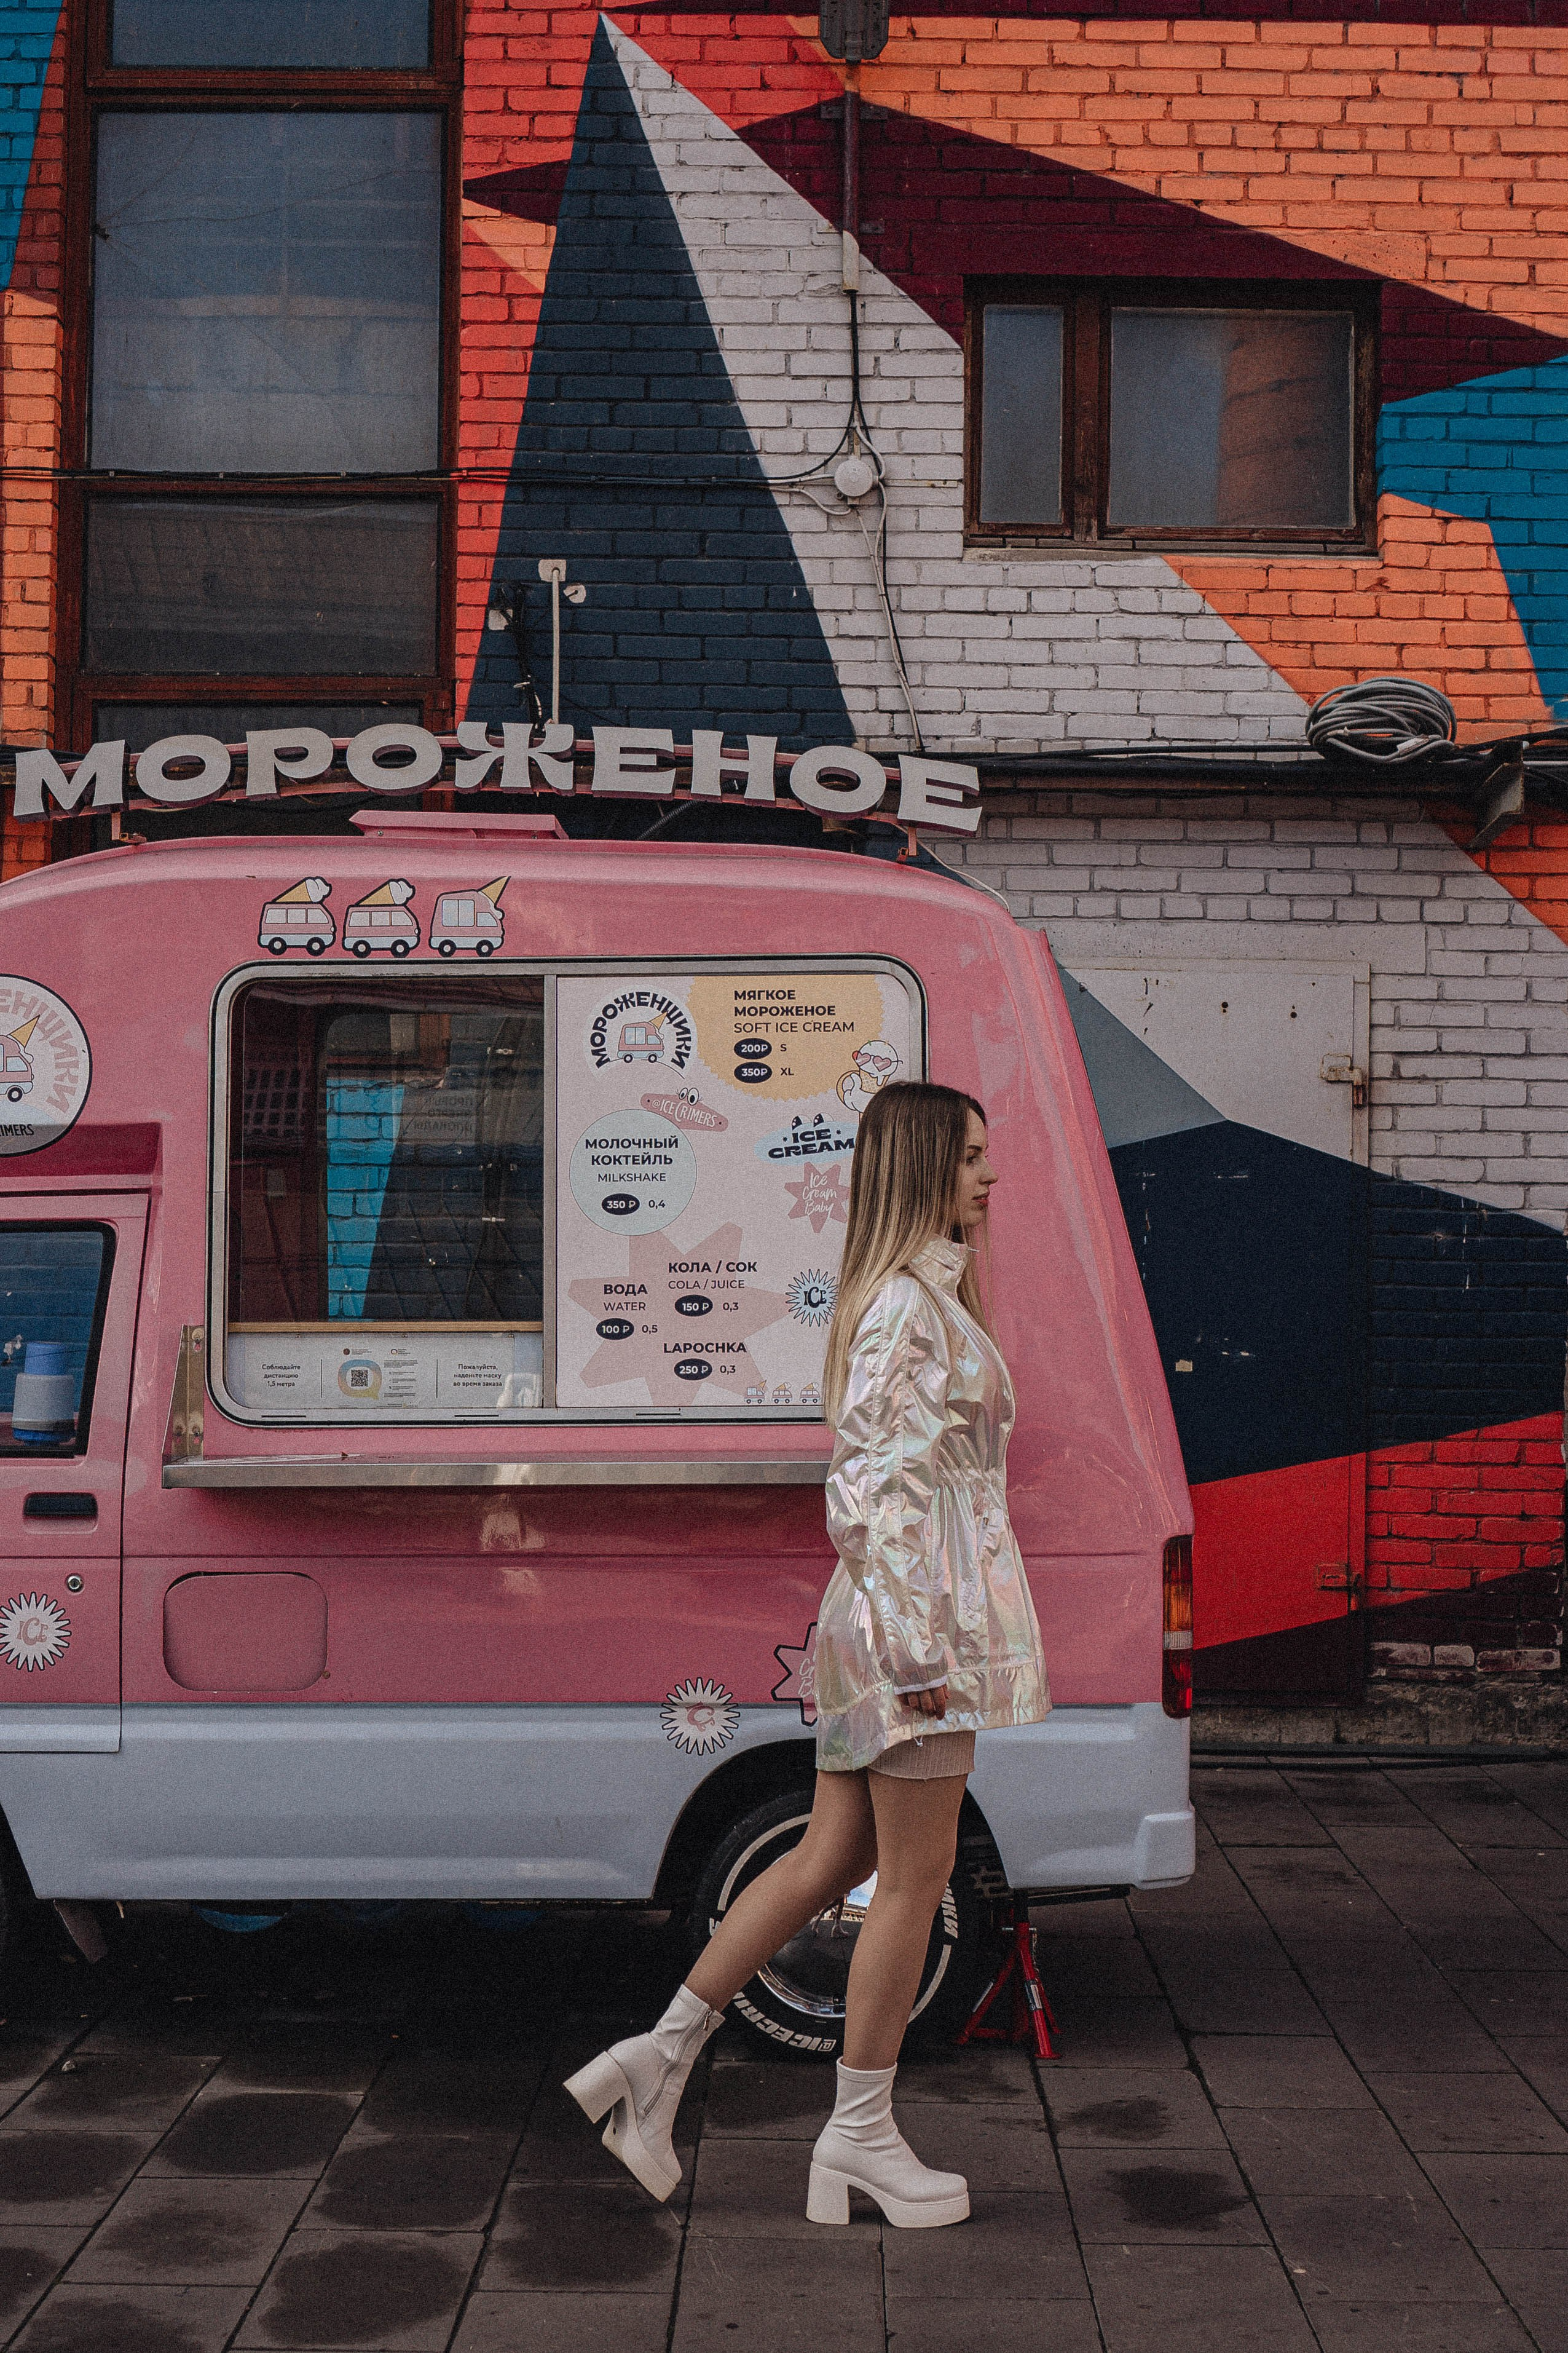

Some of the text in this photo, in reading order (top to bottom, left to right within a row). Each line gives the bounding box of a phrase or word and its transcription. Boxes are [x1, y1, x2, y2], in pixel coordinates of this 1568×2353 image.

[12, 721, 983, 833] МОРОЖЕНОЕ
[734, 989, 796, 1000] МЯГКОЕ
[734, 1005, 836, 1017] МОРОЖЕНОЕ
[589, 991, 692, 1070] МОРОЖЕНЩИКИ
[733, 1021, 854, 1034] SOFT ICE CREAM
[780, 1043, 787, 1052] S
[781, 1067, 795, 1076] XL
[652, 1099, 717, 1128] @ICECRIMERS
[0, 1123, 35, 1137] IMERS
[792, 1128, 832, 1144] ICE
[585, 1135, 679, 1149] МОЛОЧНЫЙ
[768, 1137, 855, 1159] CREAM
[591, 1152, 673, 1166] КОКТЕЙЛЬ
[597, 1173, 666, 1182] MILKSHAKE
[810, 1173, 828, 1188] Ice
[802, 1185, 838, 1201] Cream
[607, 1200, 626, 1209] 350
[648, 1200, 666, 1209] 0,4
[805, 1199, 835, 1216] Baby
[668, 1262, 712, 1273] КОЛА
[726, 1261, 757, 1273] СОК
[603, 1284, 648, 1296] ВОДА
[668, 1279, 701, 1289] COLA
[711, 1279, 745, 1289] JUICE
[803, 1286, 827, 1308] ICE
[603, 1302, 646, 1311] WATER
[682, 1302, 699, 1311] 150
[722, 1302, 739, 1312] 0,3
[602, 1325, 620, 1334] 100
[642, 1324, 658, 1335] 0,5
[663, 1342, 747, 1353] LAPOCHKA
[679, 1366, 698, 1374] 250
[720, 1365, 736, 1375] 0,3
[17, 1617, 49, 1646] ICE
